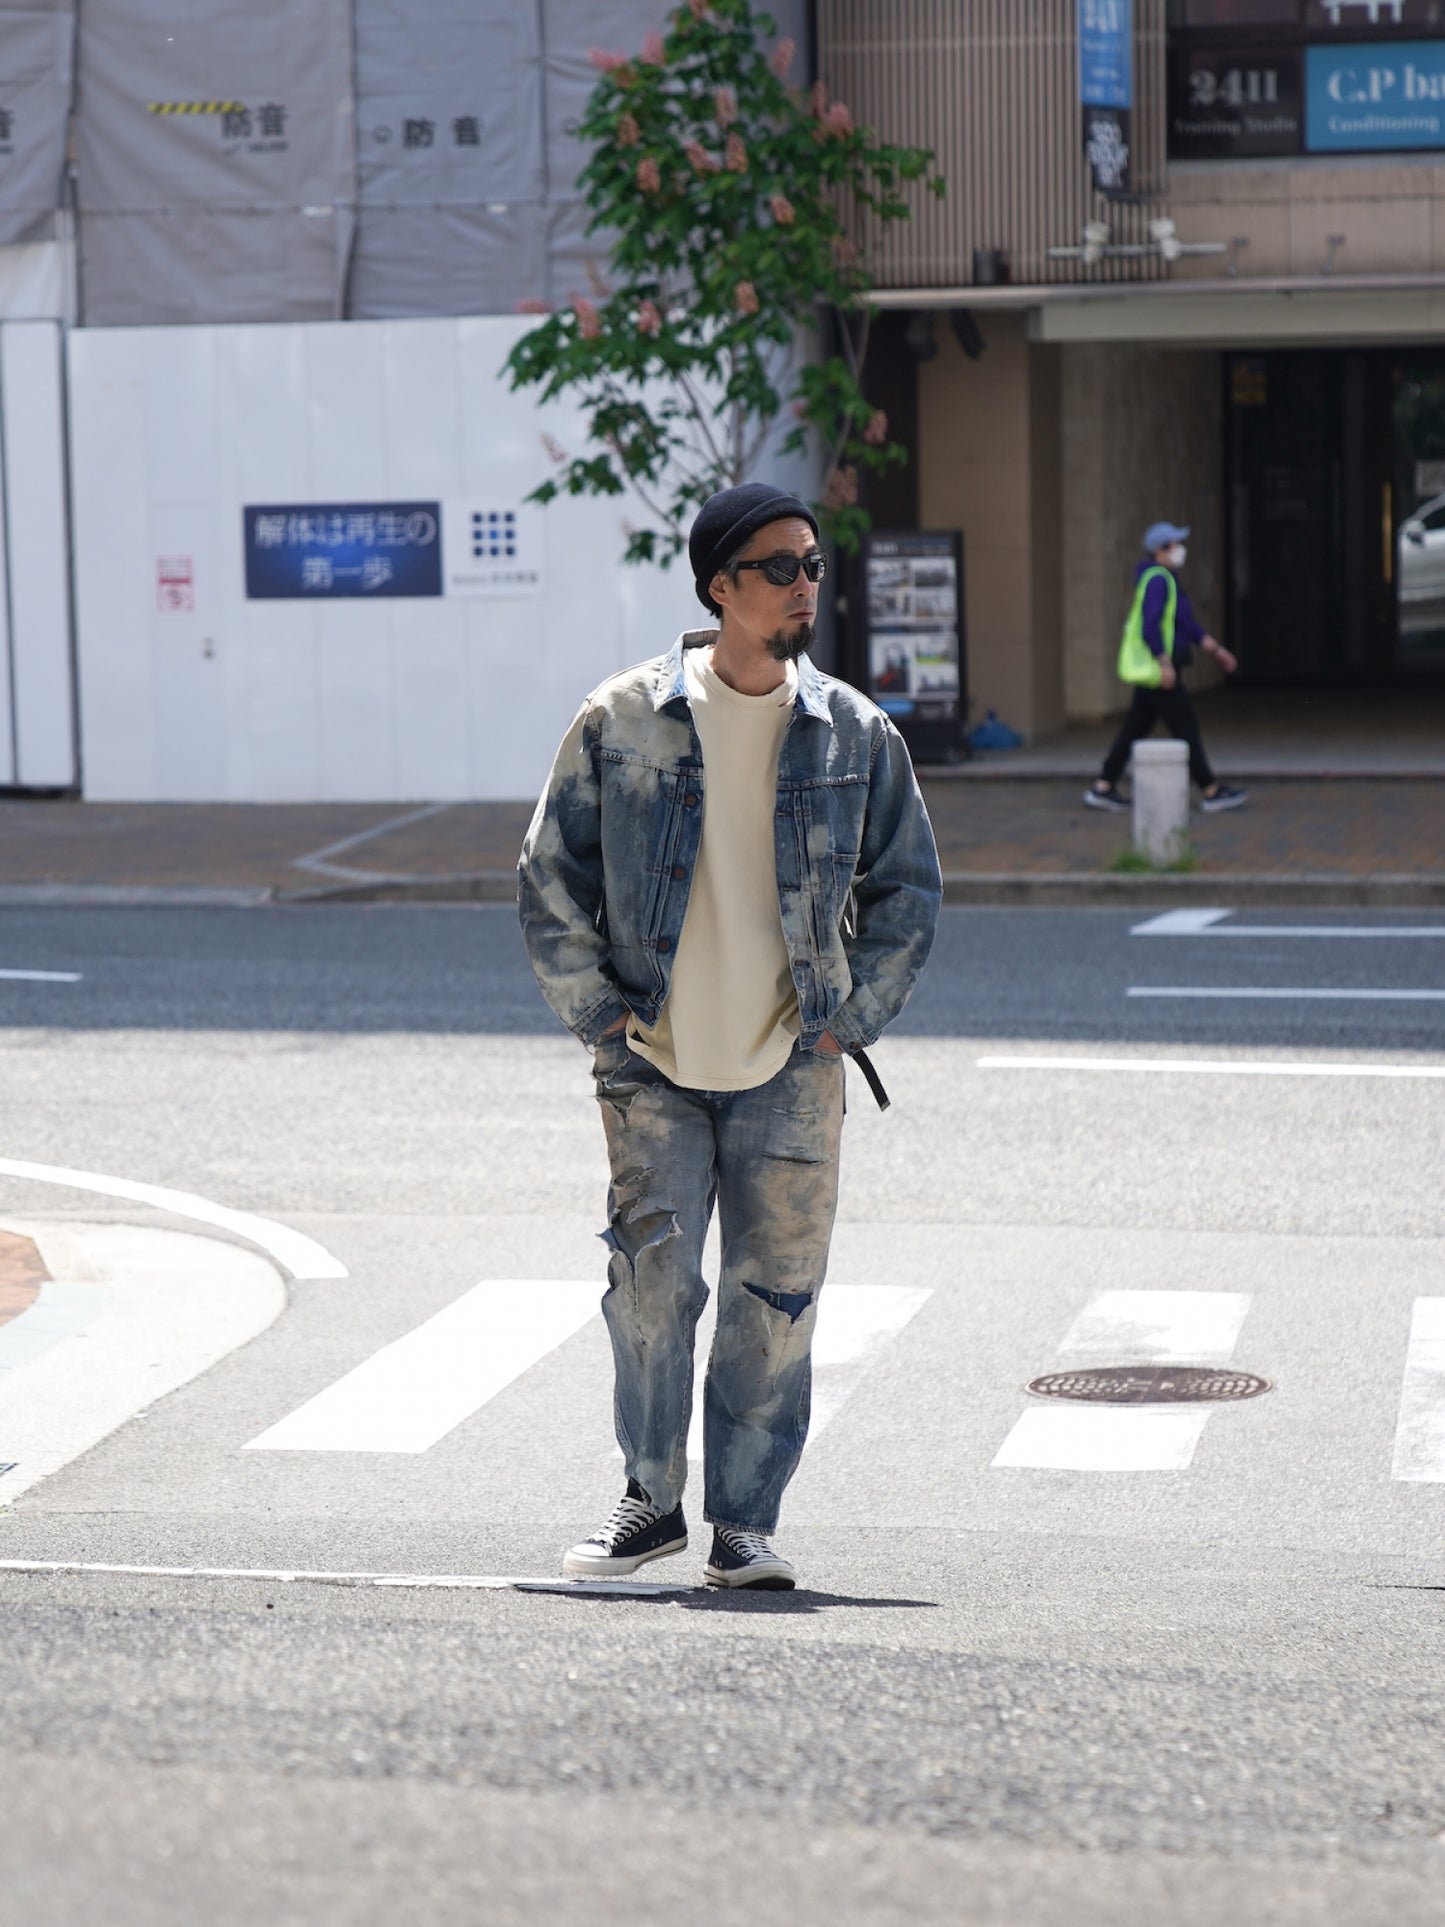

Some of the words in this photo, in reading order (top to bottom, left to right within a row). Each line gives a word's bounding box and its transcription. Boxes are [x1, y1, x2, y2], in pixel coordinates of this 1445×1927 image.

[1328, 114, 1440, 134] Conditioning
[255, 511, 437, 549] 解体は再生の
[302, 556, 394, 590] 第一歩
